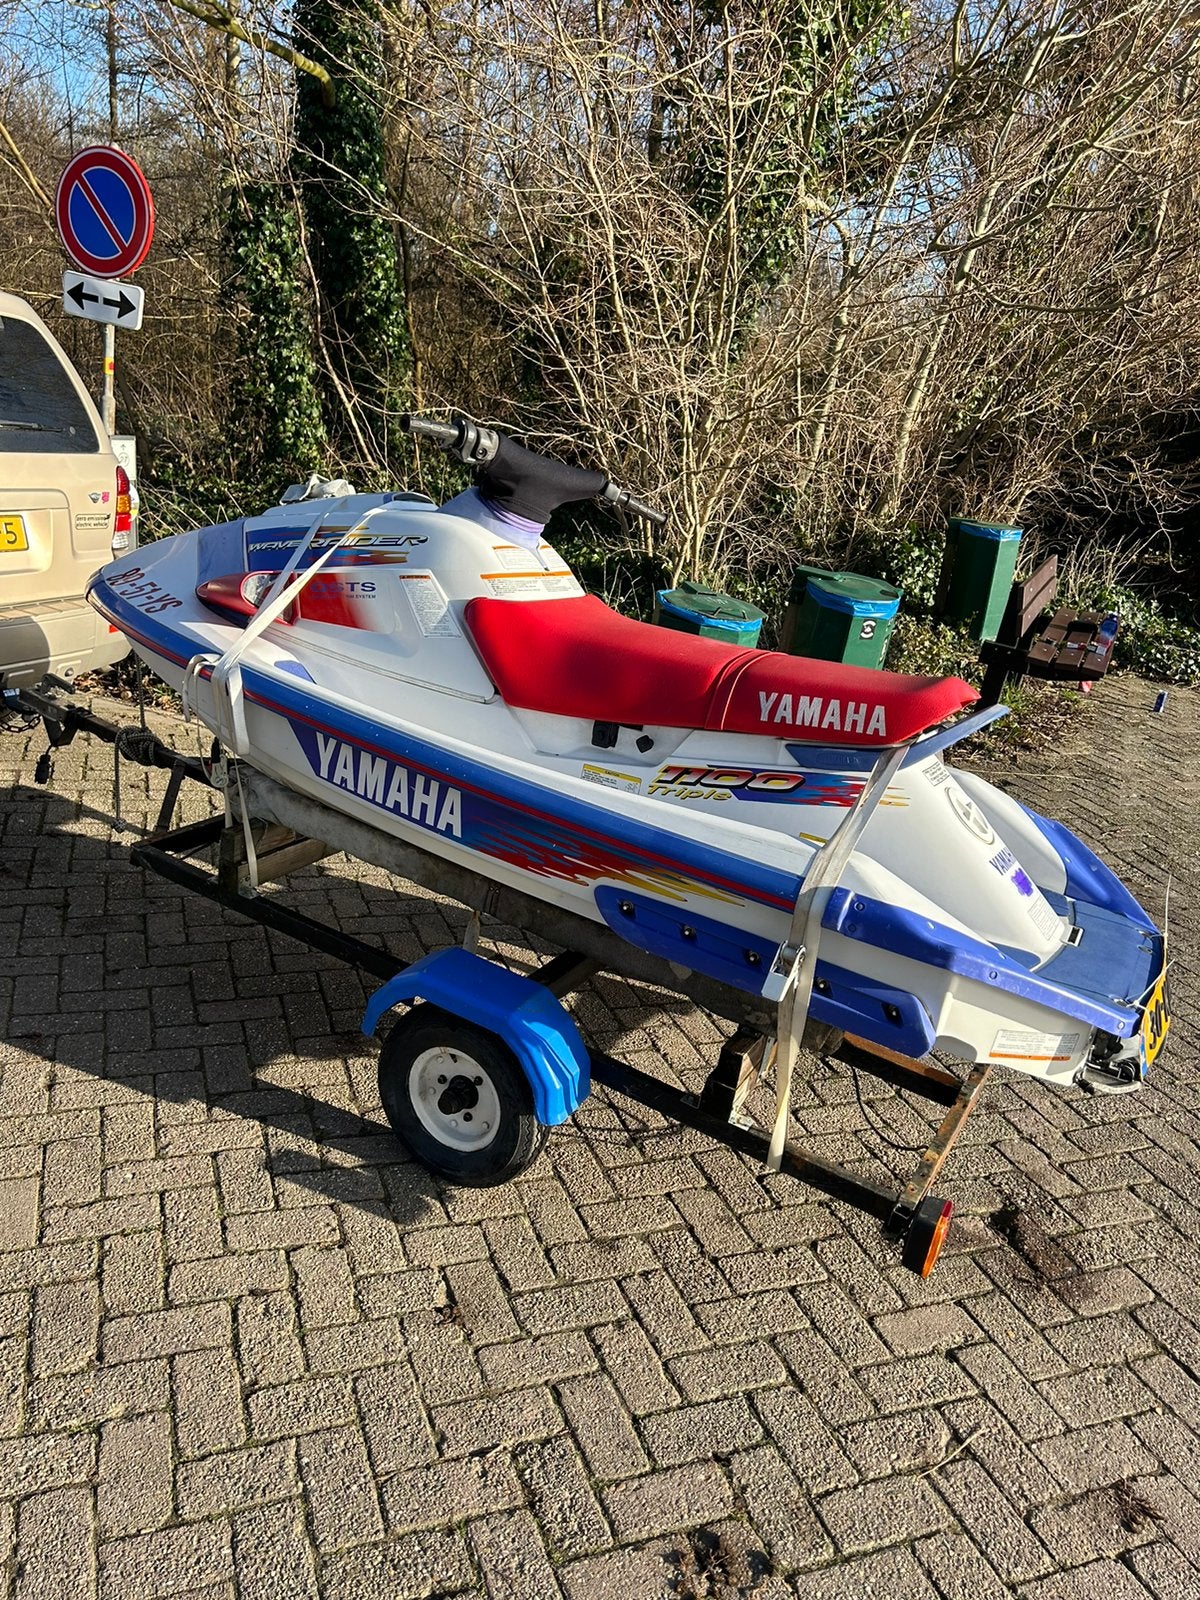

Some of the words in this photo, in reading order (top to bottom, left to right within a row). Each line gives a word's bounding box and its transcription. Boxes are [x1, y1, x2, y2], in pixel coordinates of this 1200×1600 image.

[759, 691, 886, 736] YAMAHA
[316, 731, 462, 838] YAMAHA
[648, 784, 732, 801] Triple
[652, 764, 806, 793] 1100
